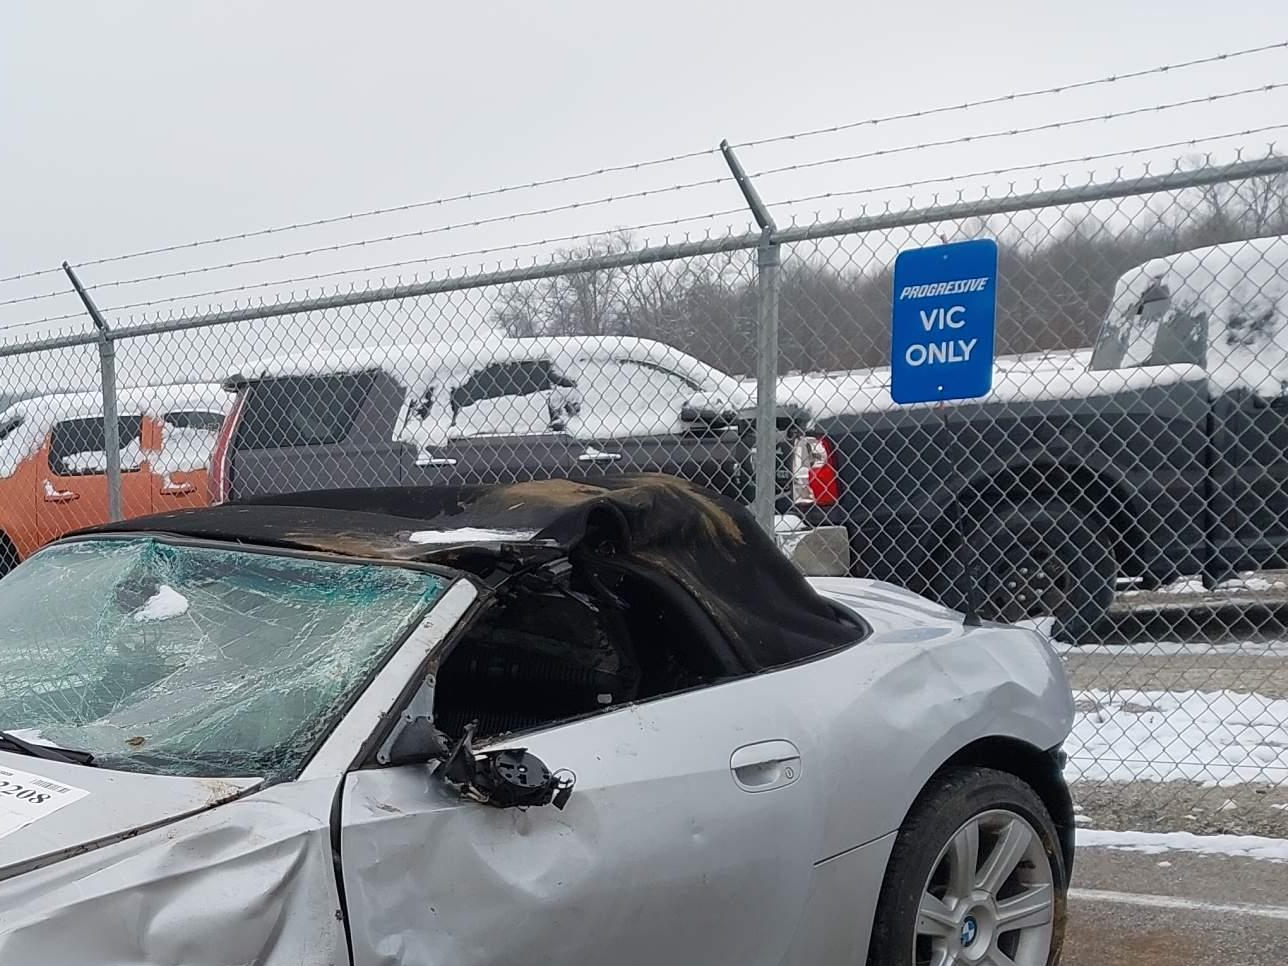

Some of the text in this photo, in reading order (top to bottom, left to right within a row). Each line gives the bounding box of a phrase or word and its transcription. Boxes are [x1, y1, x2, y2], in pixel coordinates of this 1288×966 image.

[899, 277, 988, 300] PROGRESSIVE
[919, 305, 966, 332] VIC
[905, 338, 978, 367] ONLY
